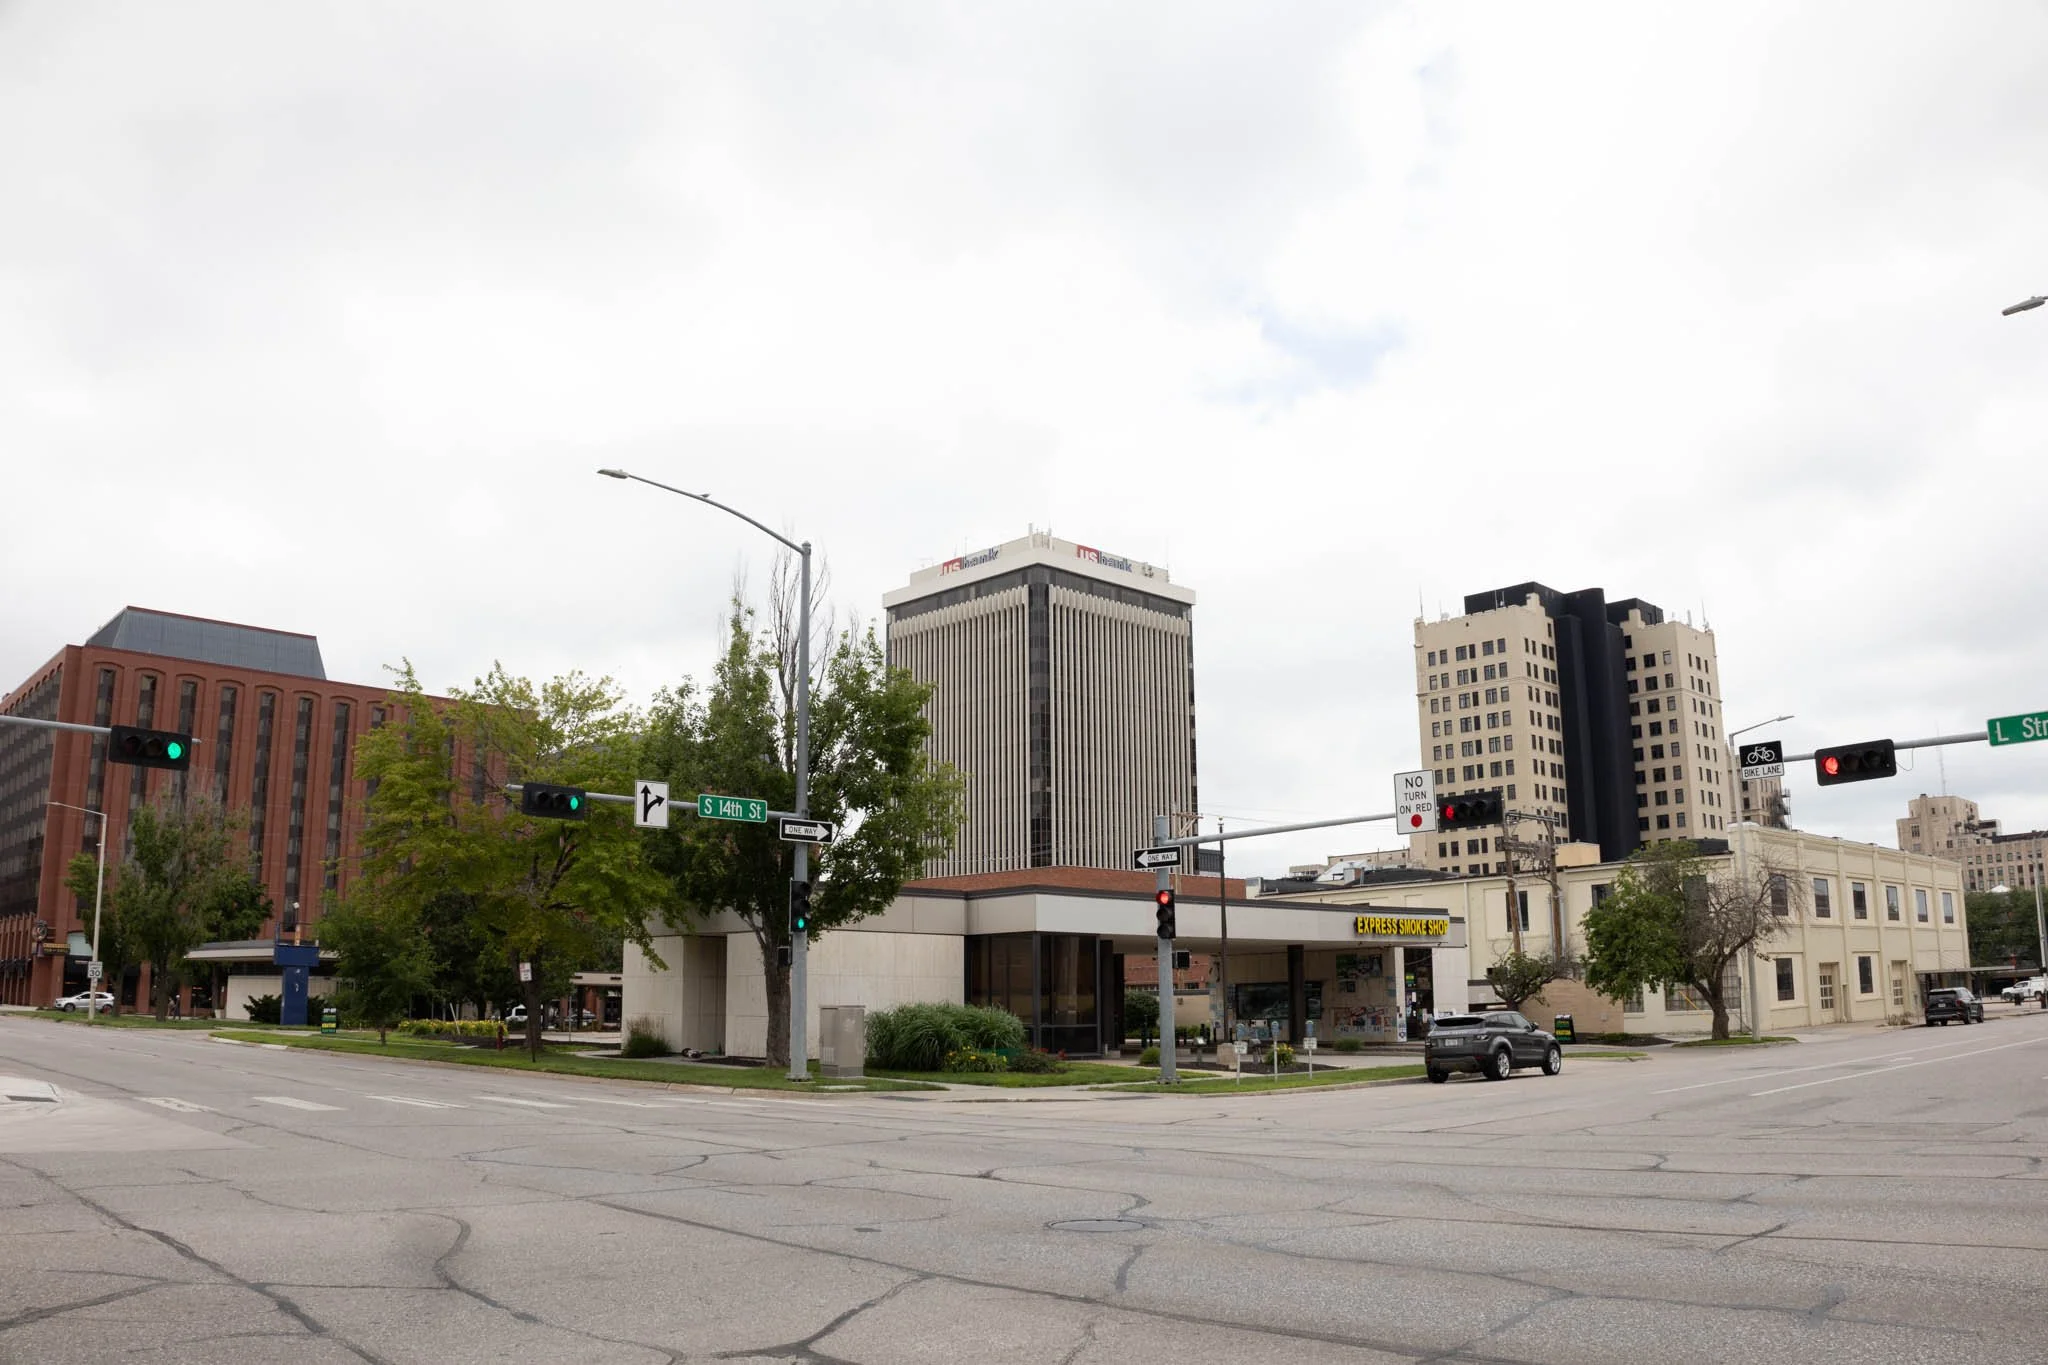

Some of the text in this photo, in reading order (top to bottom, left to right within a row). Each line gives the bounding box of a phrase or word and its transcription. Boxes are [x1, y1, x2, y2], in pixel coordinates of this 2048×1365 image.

[1996, 721, 2009, 742] L
[1744, 765, 1781, 777] BIKE LANE
[1405, 776, 1423, 789] NO
[1404, 791, 1427, 801] TURN
[704, 798, 761, 819] S 14th St
[1400, 803, 1432, 814] ON RED
[789, 826, 817, 835] ONE WAY
[1162, 853, 1173, 861] WAY
[1357, 916, 1449, 936] EXPRESS SMOKE SHOP
[89, 969, 101, 977] 30
